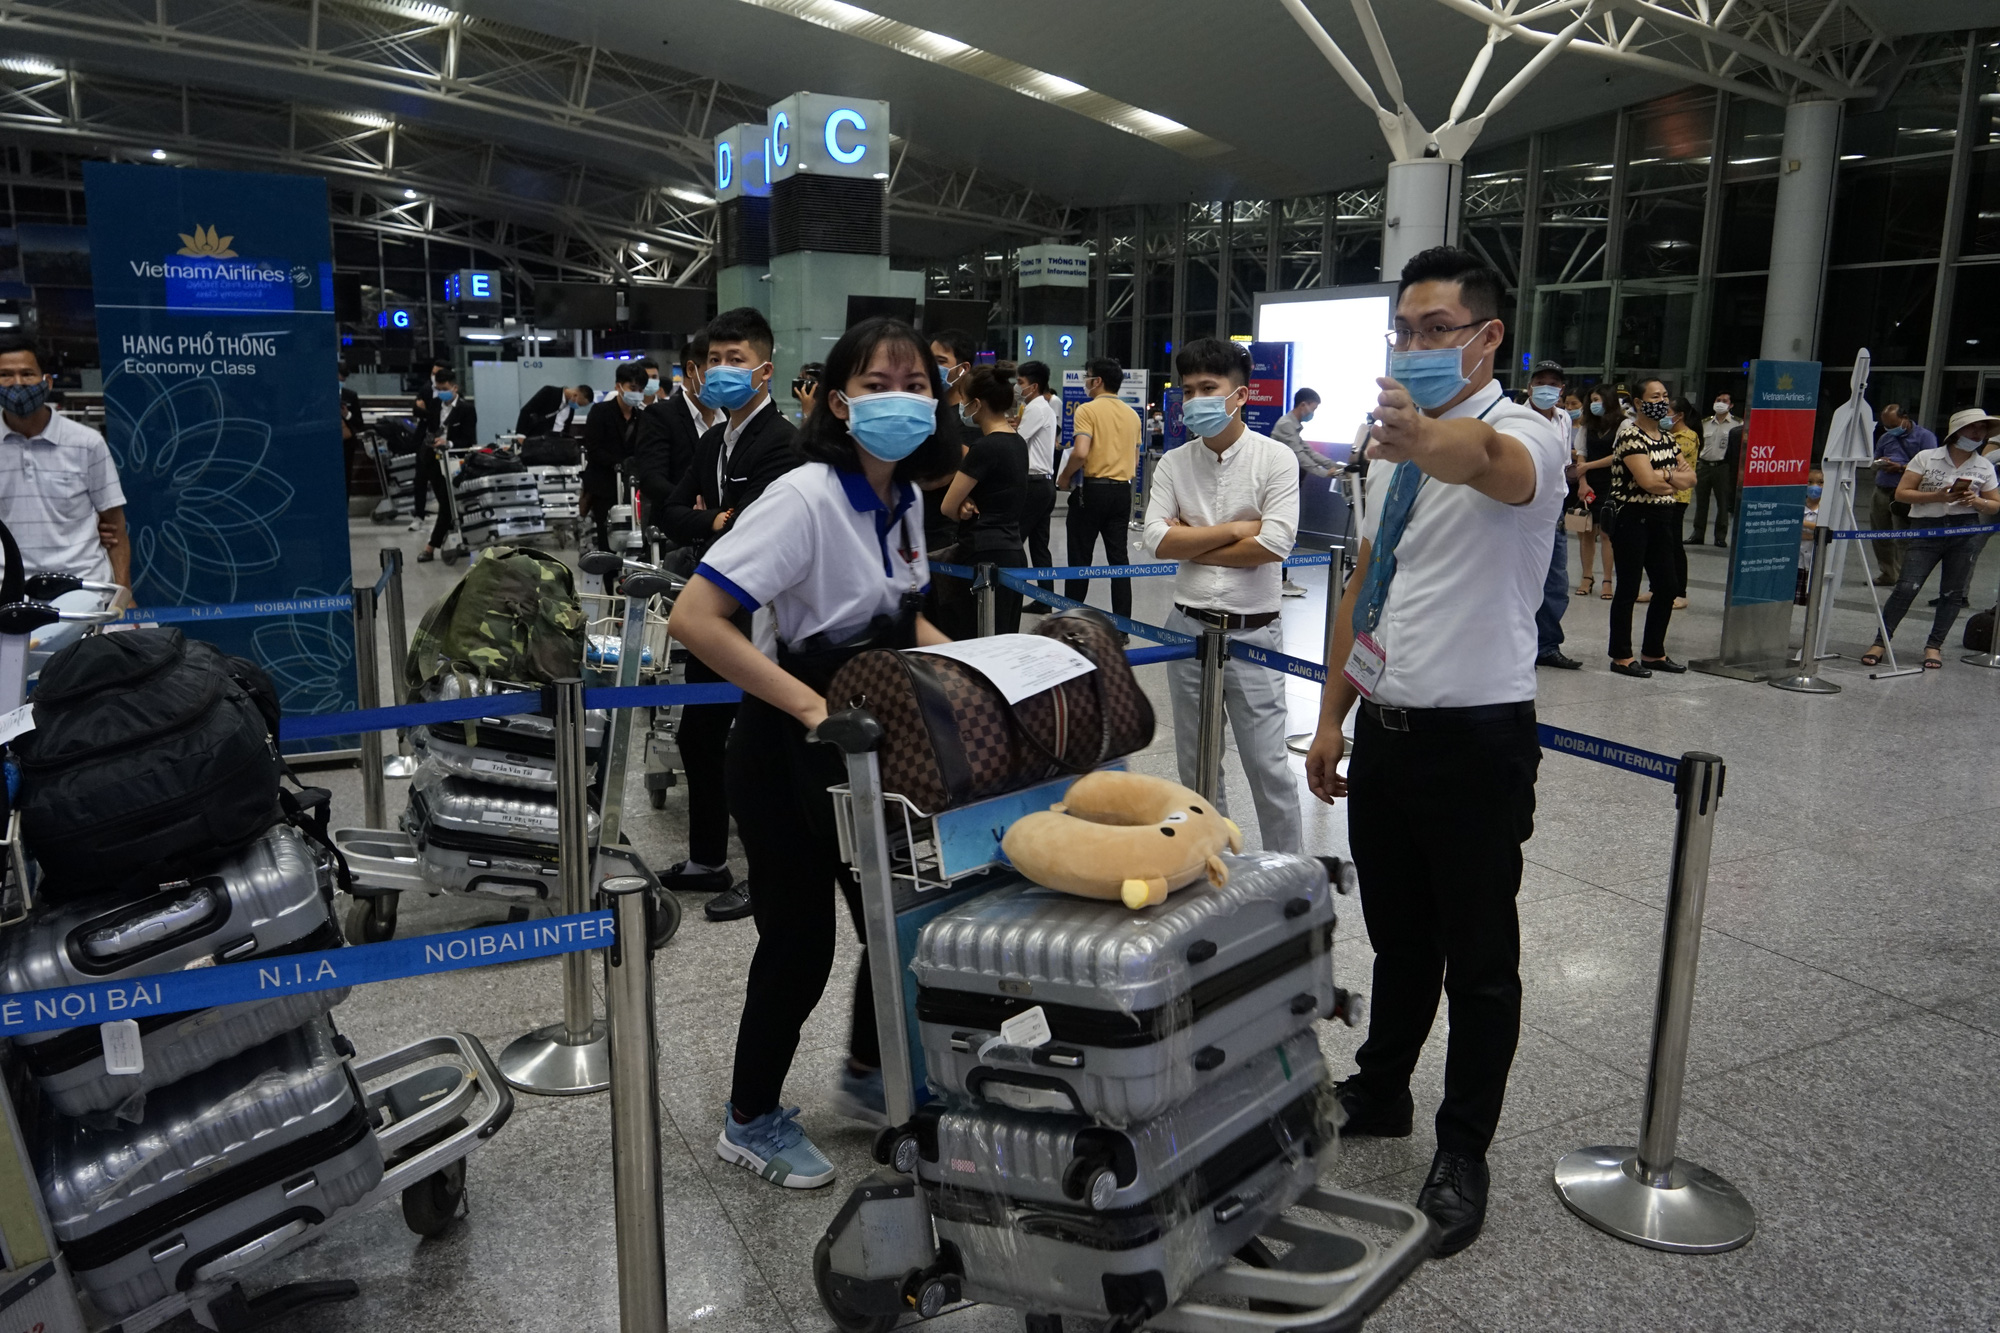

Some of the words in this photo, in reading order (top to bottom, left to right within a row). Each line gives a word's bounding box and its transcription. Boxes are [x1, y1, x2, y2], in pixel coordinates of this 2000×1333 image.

[773, 111, 789, 167] C
[824, 108, 867, 164] C
[718, 141, 733, 190] D
[130, 260, 212, 280] Vietnam
[215, 264, 285, 282] Airlines
[1047, 268, 1087, 276] Information
[472, 274, 490, 297] E
[393, 310, 409, 328] G
[122, 335, 173, 358] HẠNG
[178, 331, 214, 355] PHỔ
[217, 334, 276, 356] THÔNG
[124, 360, 205, 378] Economy
[210, 360, 256, 375] Class
[523, 361, 543, 369] C-03
[1762, 392, 1784, 401] Vietnam
[1784, 393, 1805, 401] Airlines
[1750, 445, 1775, 459] SKY
[1749, 459, 1804, 473] PRIORITY
[191, 607, 223, 617] N.I.A
[254, 601, 297, 613] NOIBAI
[1248, 648, 1267, 663] N.I.A
[1288, 660, 1312, 677] CẢNG
[1554, 734, 1599, 756] NOIBAI
[34, 991, 96, 1021] NỘI
[107, 981, 162, 1011] BÀI
[258, 958, 337, 989] N.I.A
[425, 930, 525, 964] NOIBAI
[534, 917, 616, 948] INTER
